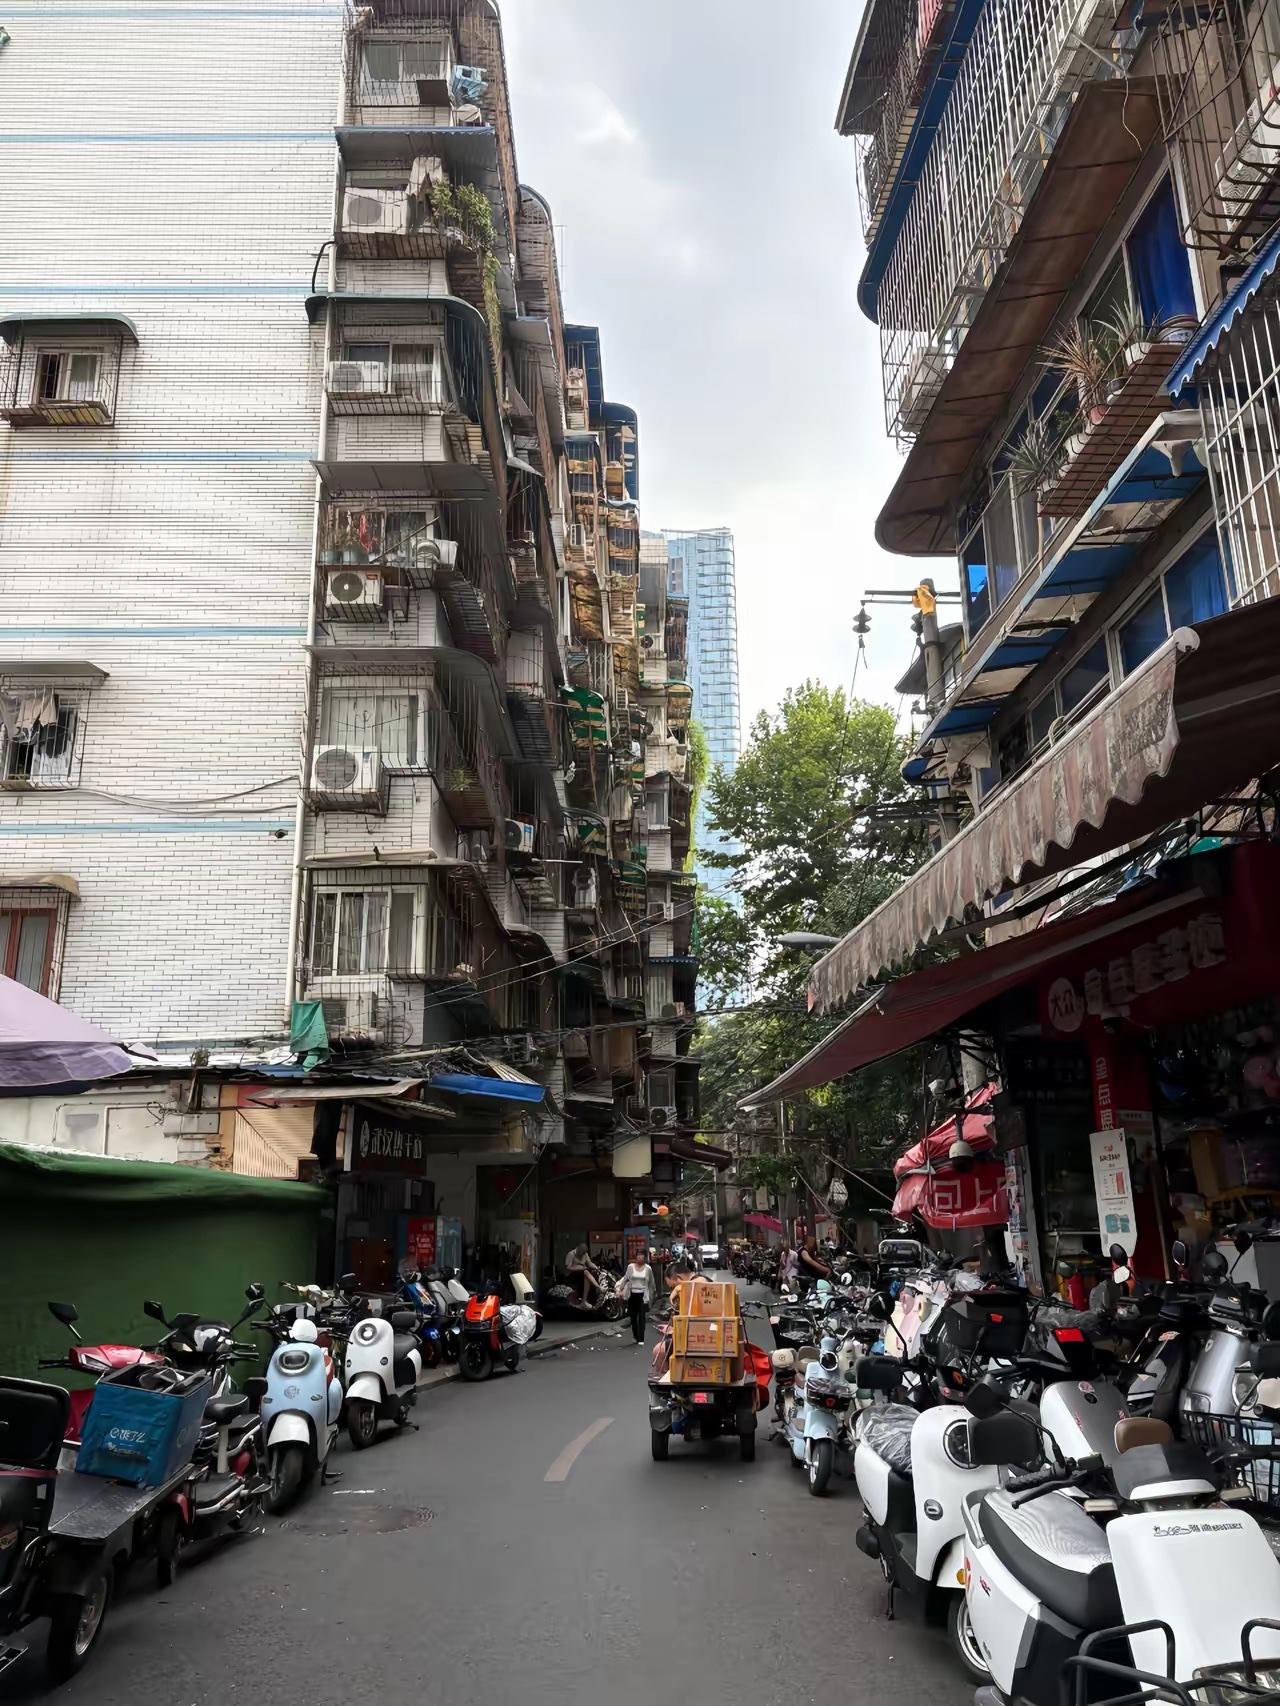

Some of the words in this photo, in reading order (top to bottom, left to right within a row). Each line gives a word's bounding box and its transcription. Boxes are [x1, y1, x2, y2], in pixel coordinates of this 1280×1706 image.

[371, 1128, 423, 1159] 武汉热干面
